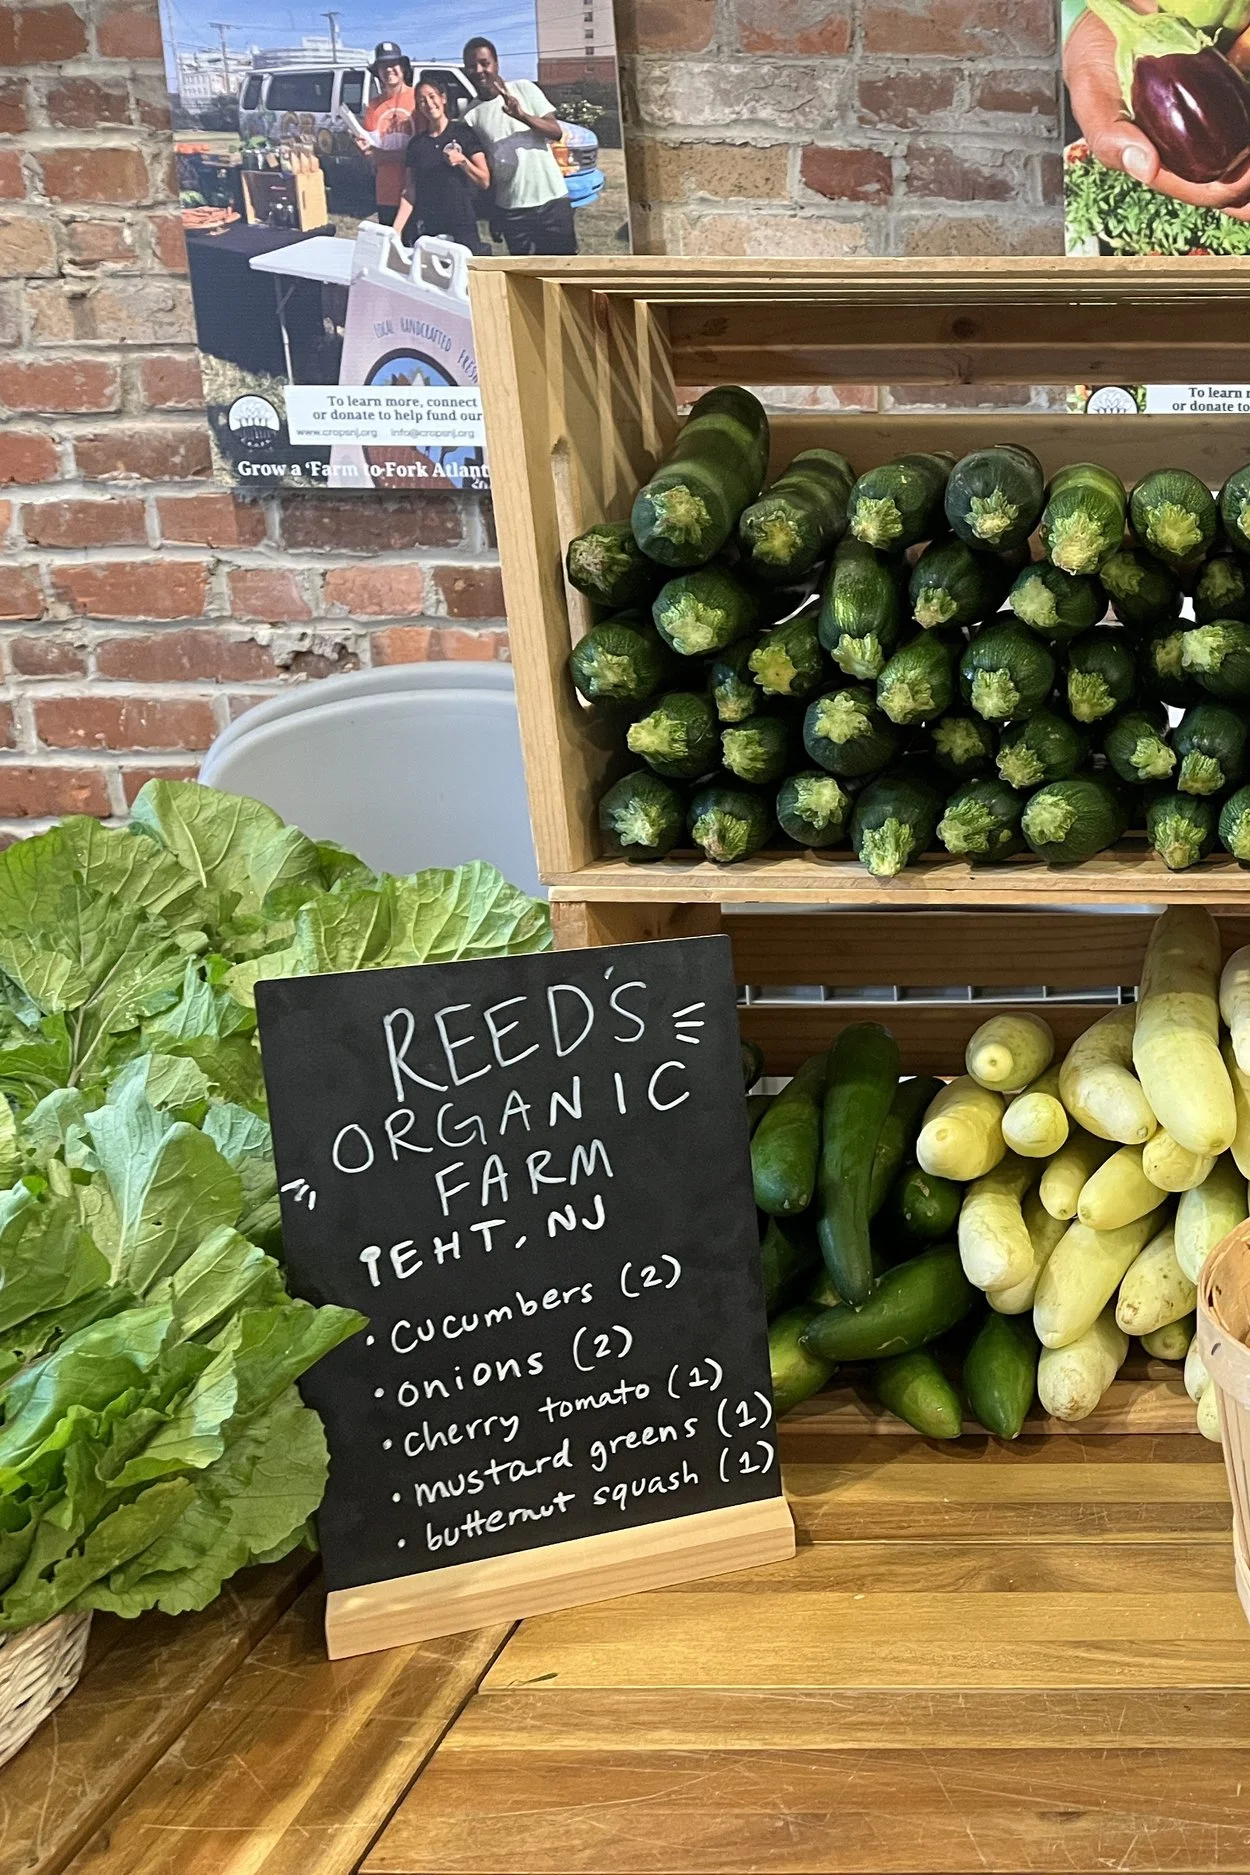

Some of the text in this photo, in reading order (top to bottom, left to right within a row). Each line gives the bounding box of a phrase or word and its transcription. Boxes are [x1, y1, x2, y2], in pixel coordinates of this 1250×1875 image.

[327, 394, 478, 409] To learn more, connect
[1172, 402, 1187, 412] or
[1189, 401, 1234, 412] donate
[1237, 402, 1250, 412] to
[1188, 387, 1204, 398] To
[1208, 386, 1242, 399] learn
[296, 428, 378, 439] www.cropsnj.org
[312, 408, 484, 424] or donate to help fund our
[237, 461, 287, 477] Grow
[291, 463, 302, 476] a
[382, 965, 648, 1103] REED'S
[331, 1060, 690, 1174] ORGANIC
[434, 1138, 614, 1217] FARM
[547, 1193, 606, 1238] NJ
[620, 1253, 682, 1298] (2)
[397, 1324, 633, 1407] onions (2)
[404, 1357, 724, 1457] cherry tomato (1)
[414, 1390, 773, 1508] mustard greens (1)
[426, 1440, 774, 1552] butternut squash (1)
